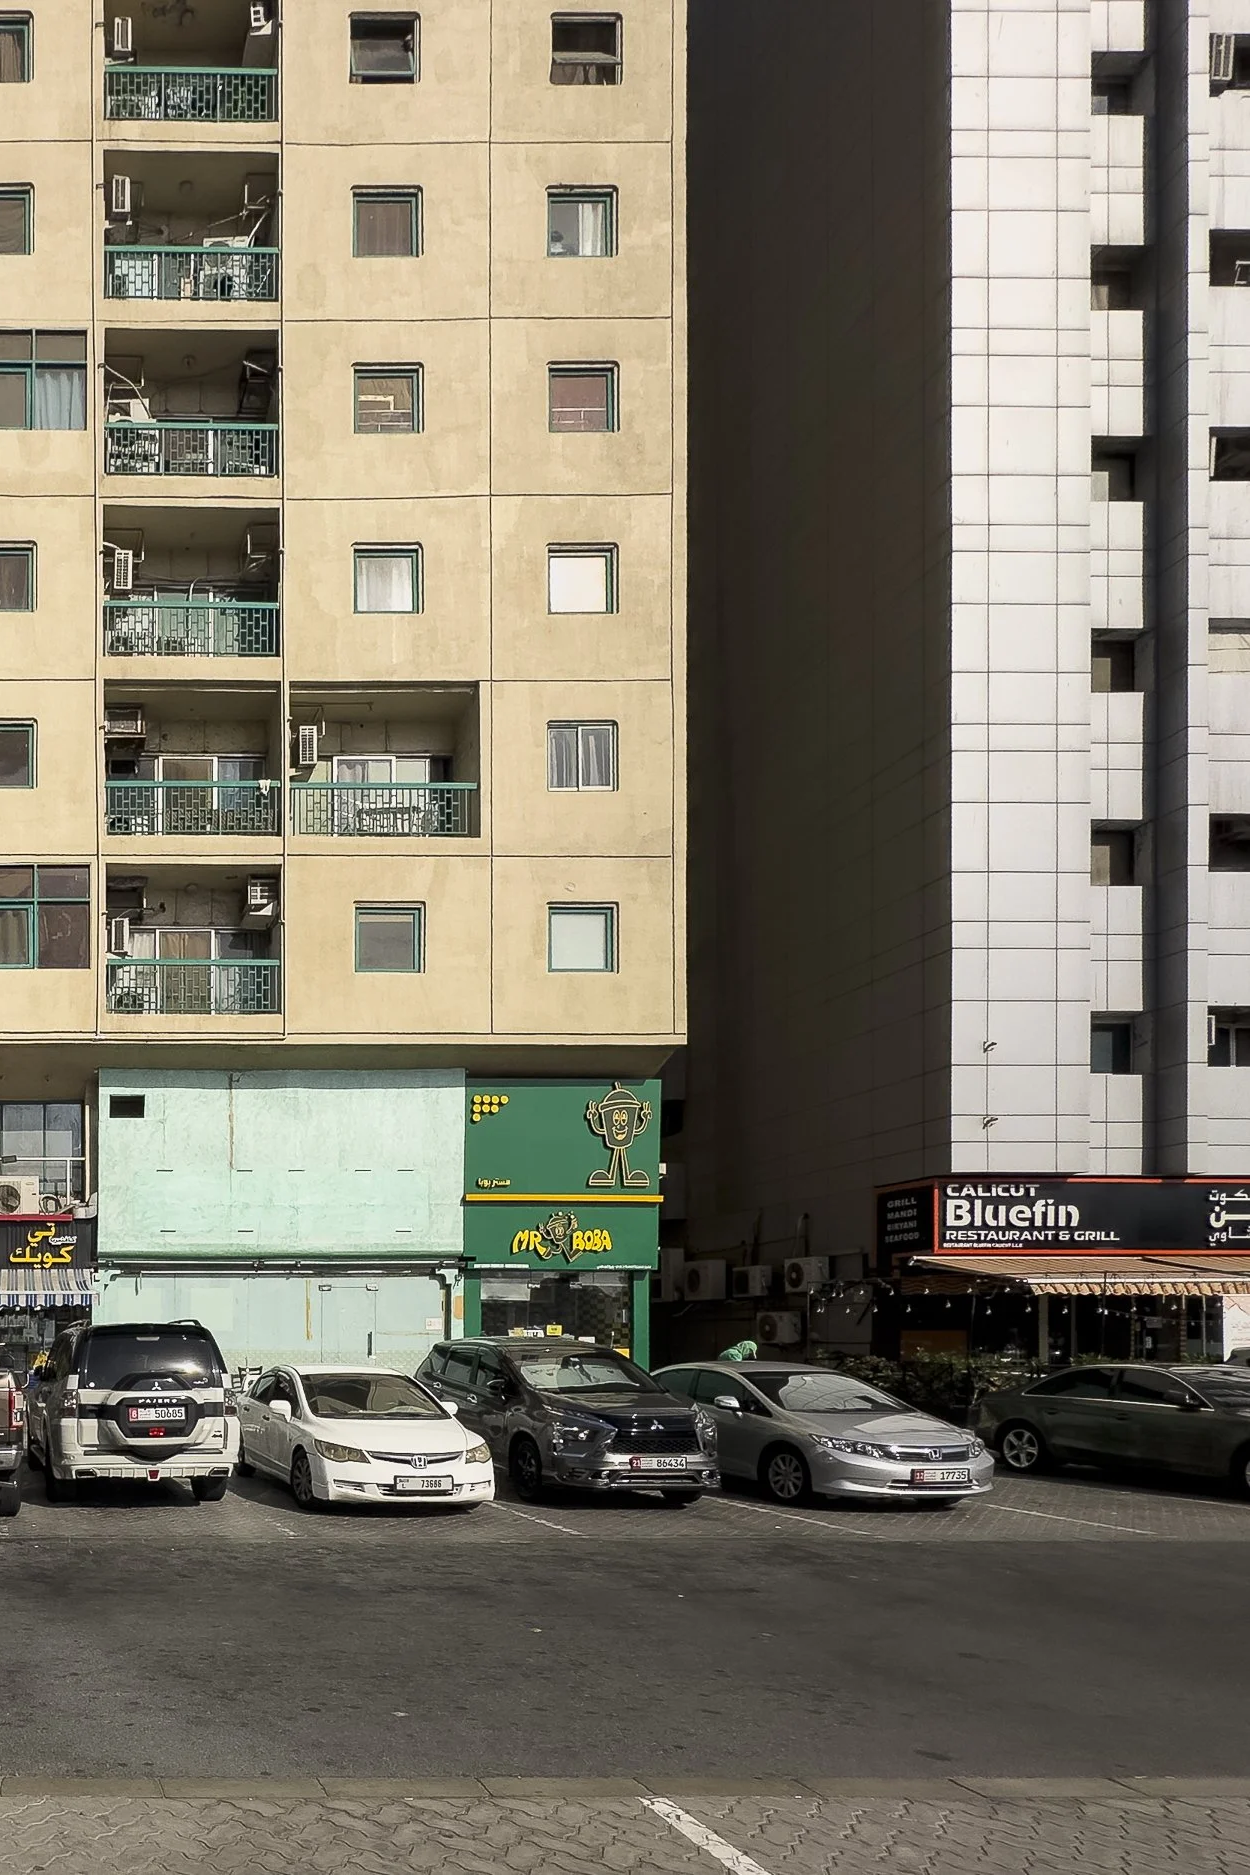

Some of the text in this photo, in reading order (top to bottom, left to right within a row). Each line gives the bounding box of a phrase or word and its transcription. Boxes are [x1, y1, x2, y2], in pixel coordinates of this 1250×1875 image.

[946, 1184, 1040, 1197] CALICUT
[887, 1196, 917, 1208] GRILL
[887, 1208, 917, 1220] MANDI
[946, 1199, 1080, 1227] Bluefin
[27, 1222, 56, 1247] تي
[885, 1232, 920, 1243] SEAFOOD
[945, 1230, 1121, 1241] RESTAURANT & GRILL
[512, 1229, 613, 1256] MR BOBA
[9, 1245, 75, 1269] كويك
[656, 1457, 685, 1468] 86434
[940, 1470, 967, 1481] 17735
